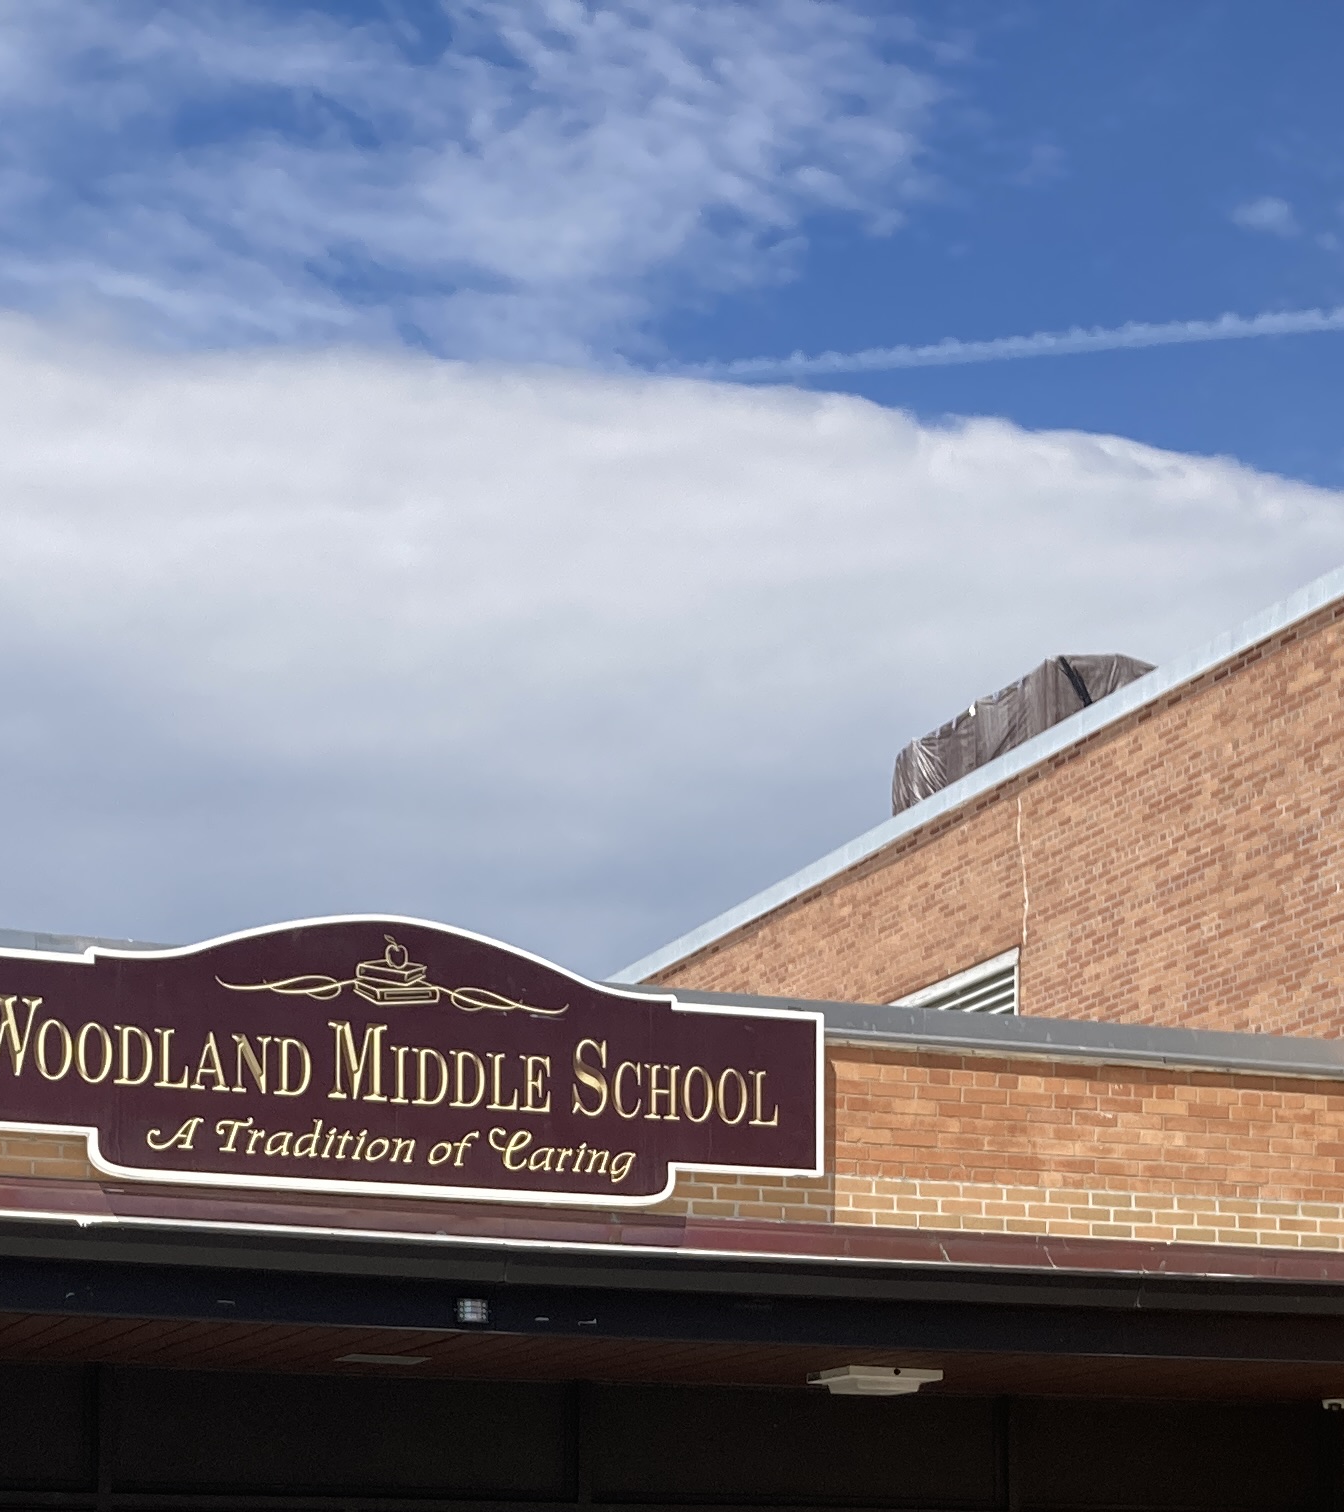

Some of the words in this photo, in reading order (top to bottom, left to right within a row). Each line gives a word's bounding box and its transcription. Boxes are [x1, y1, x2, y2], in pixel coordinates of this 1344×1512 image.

[328, 1020, 552, 1114] MIDDLE
[572, 1038, 779, 1127] SCHOOL
[146, 1116, 204, 1151] A
[216, 1117, 416, 1163] Tradition
[428, 1130, 479, 1168] of
[488, 1128, 637, 1184] Caring
